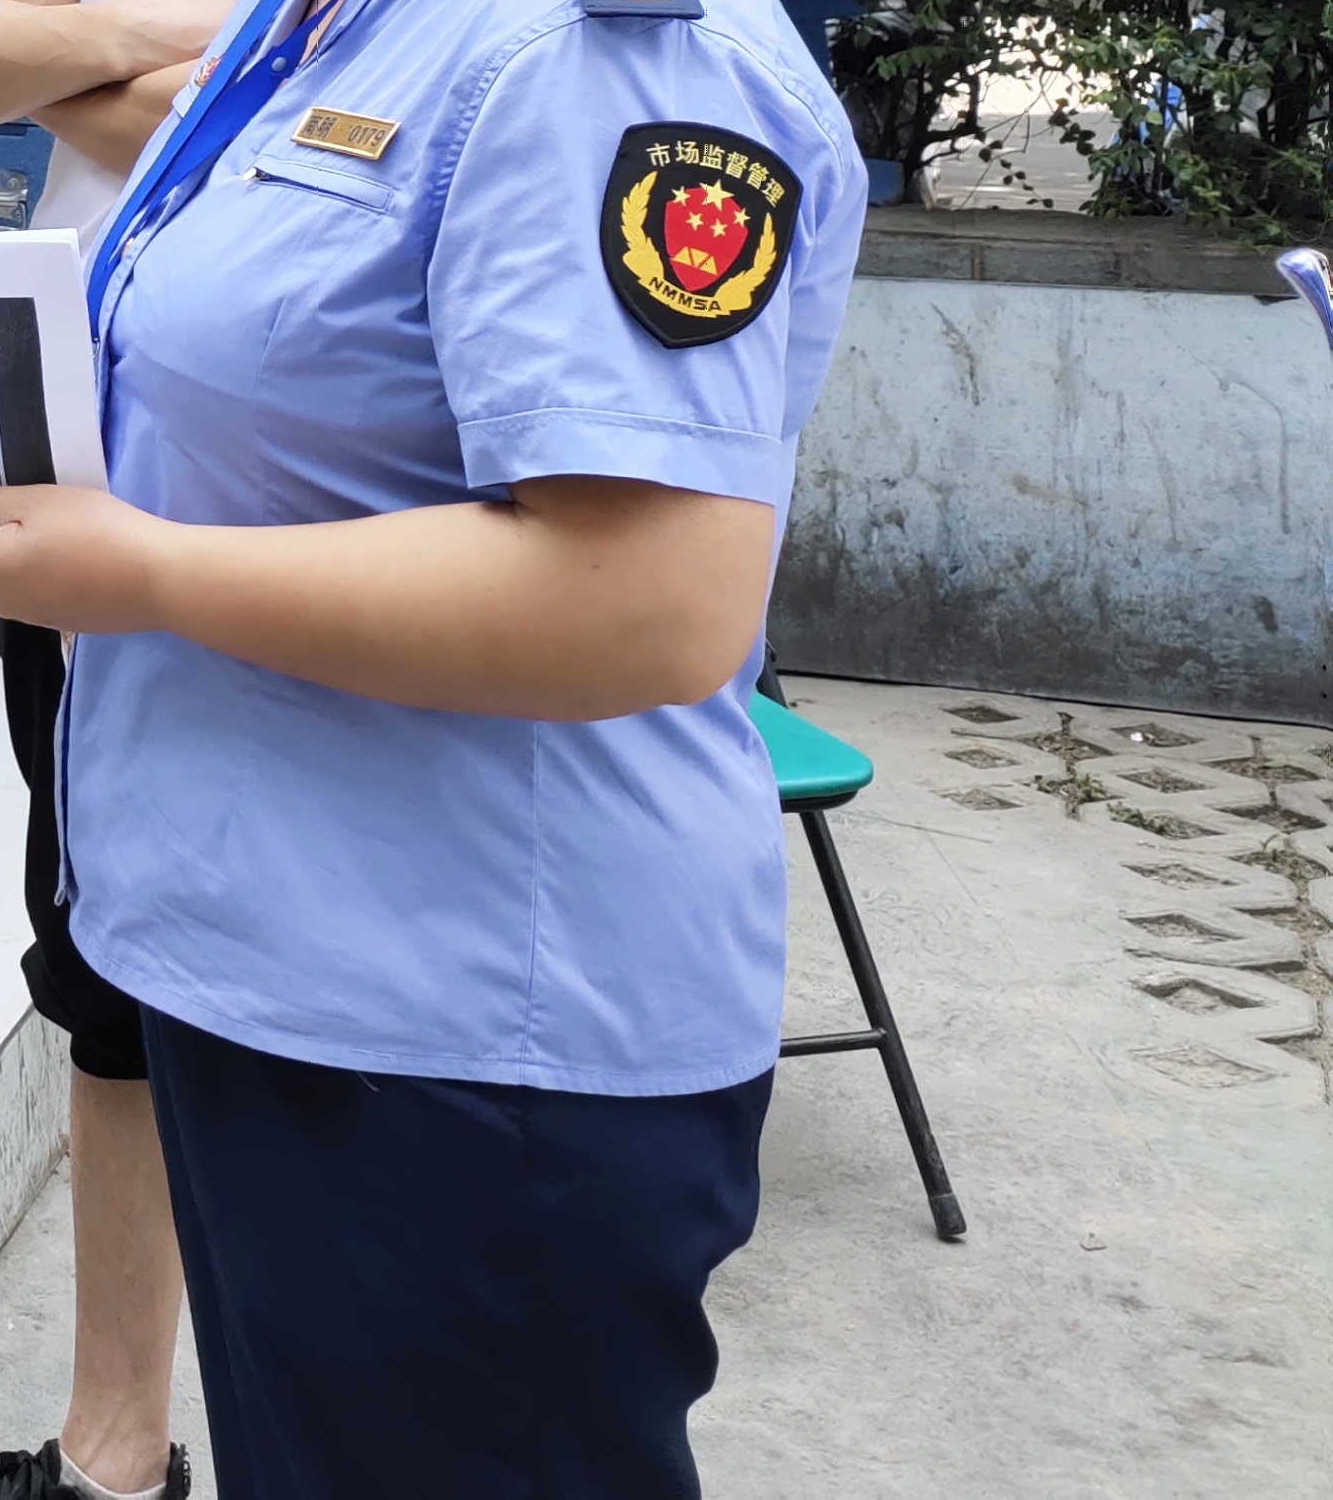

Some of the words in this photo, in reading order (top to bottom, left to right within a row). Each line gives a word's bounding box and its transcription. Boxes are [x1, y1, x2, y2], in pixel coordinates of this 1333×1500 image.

[347, 125, 386, 147] 0179
[646, 140, 785, 208] 市场监督管理
[648, 276, 723, 312] NMMSA
